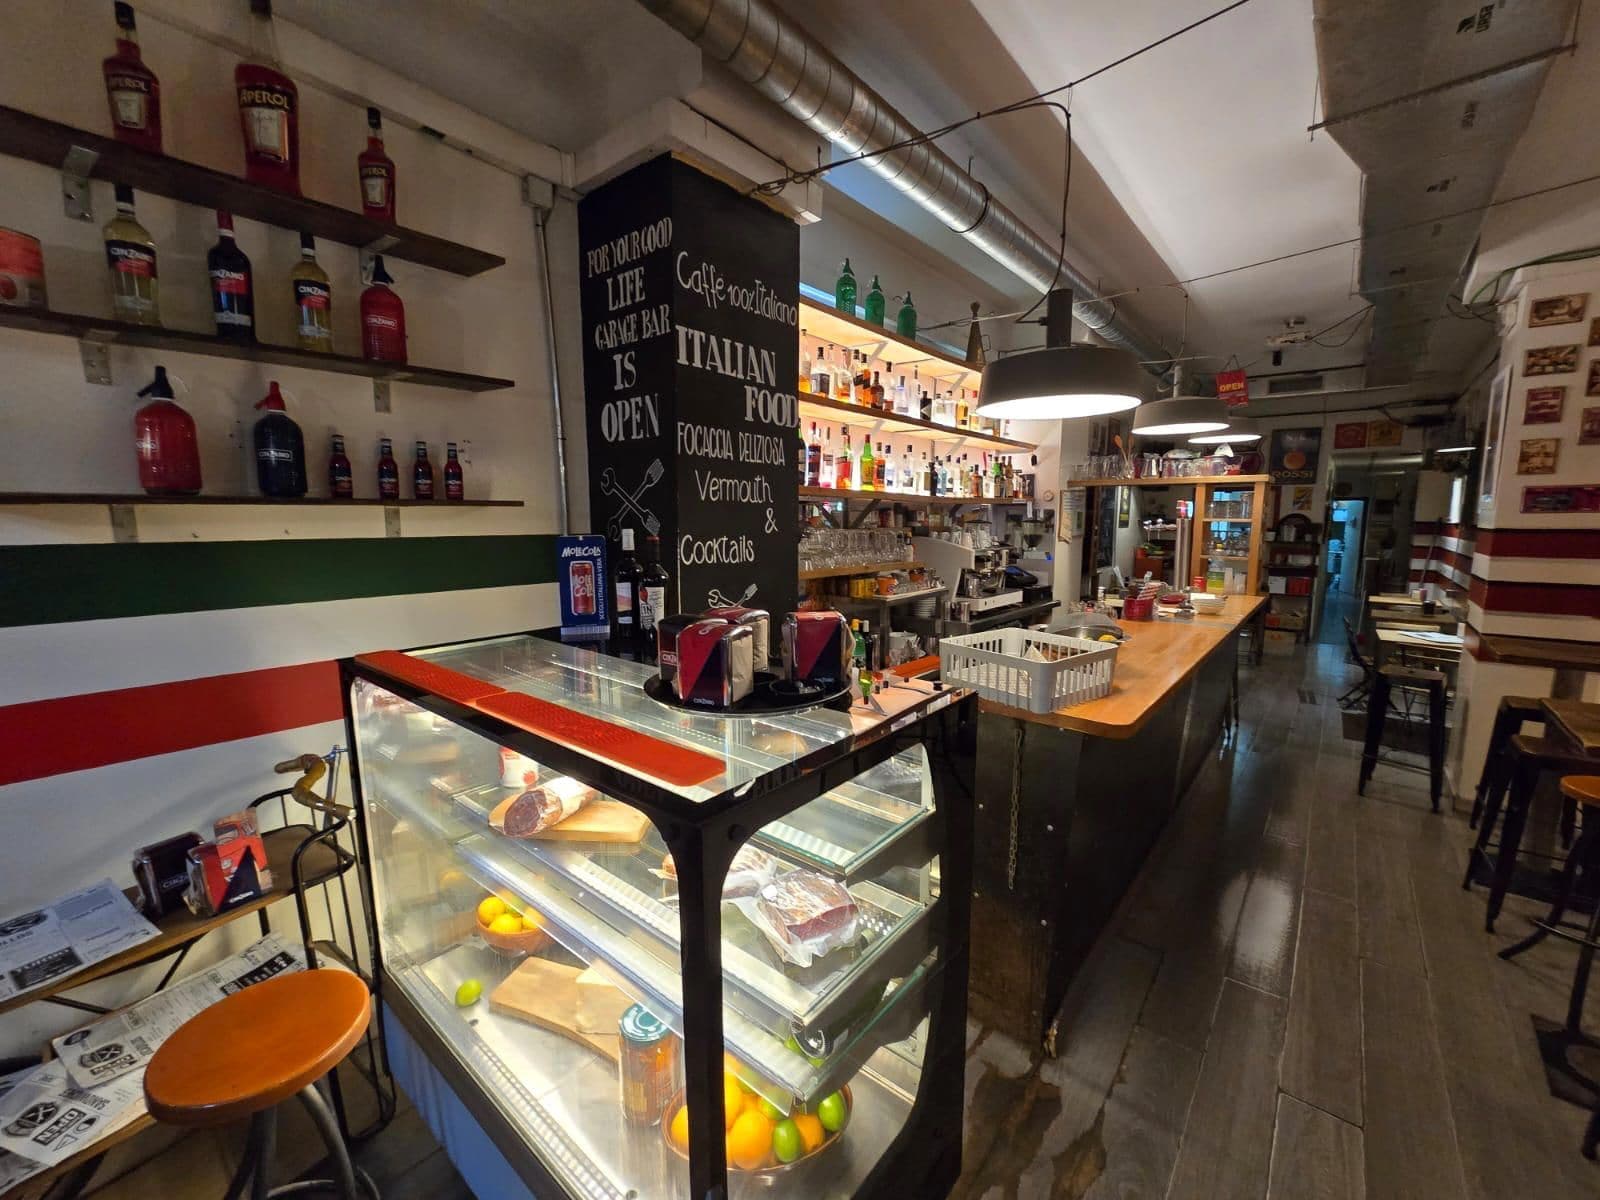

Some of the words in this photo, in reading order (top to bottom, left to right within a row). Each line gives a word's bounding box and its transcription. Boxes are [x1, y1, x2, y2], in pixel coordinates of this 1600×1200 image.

[239, 89, 290, 109] APEROL
[587, 243, 610, 278] FOR
[610, 230, 641, 268] YOUR
[641, 217, 673, 254] GOOD
[606, 266, 646, 312] LIFE
[754, 279, 797, 327] Italiano
[594, 314, 638, 351] GARAGE
[642, 303, 671, 339] BAR
[612, 351, 637, 391] IS
[675, 324, 777, 386] ITALIAN
[744, 385, 799, 430] FOOD
[1219, 382, 1244, 392] OPEN
[601, 393, 660, 443] OPEN
[677, 421, 734, 461] FOCACCIA
[739, 433, 786, 467] DELIZIOSA
[695, 469, 774, 504] Vermouth
[764, 507, 778, 534] &
